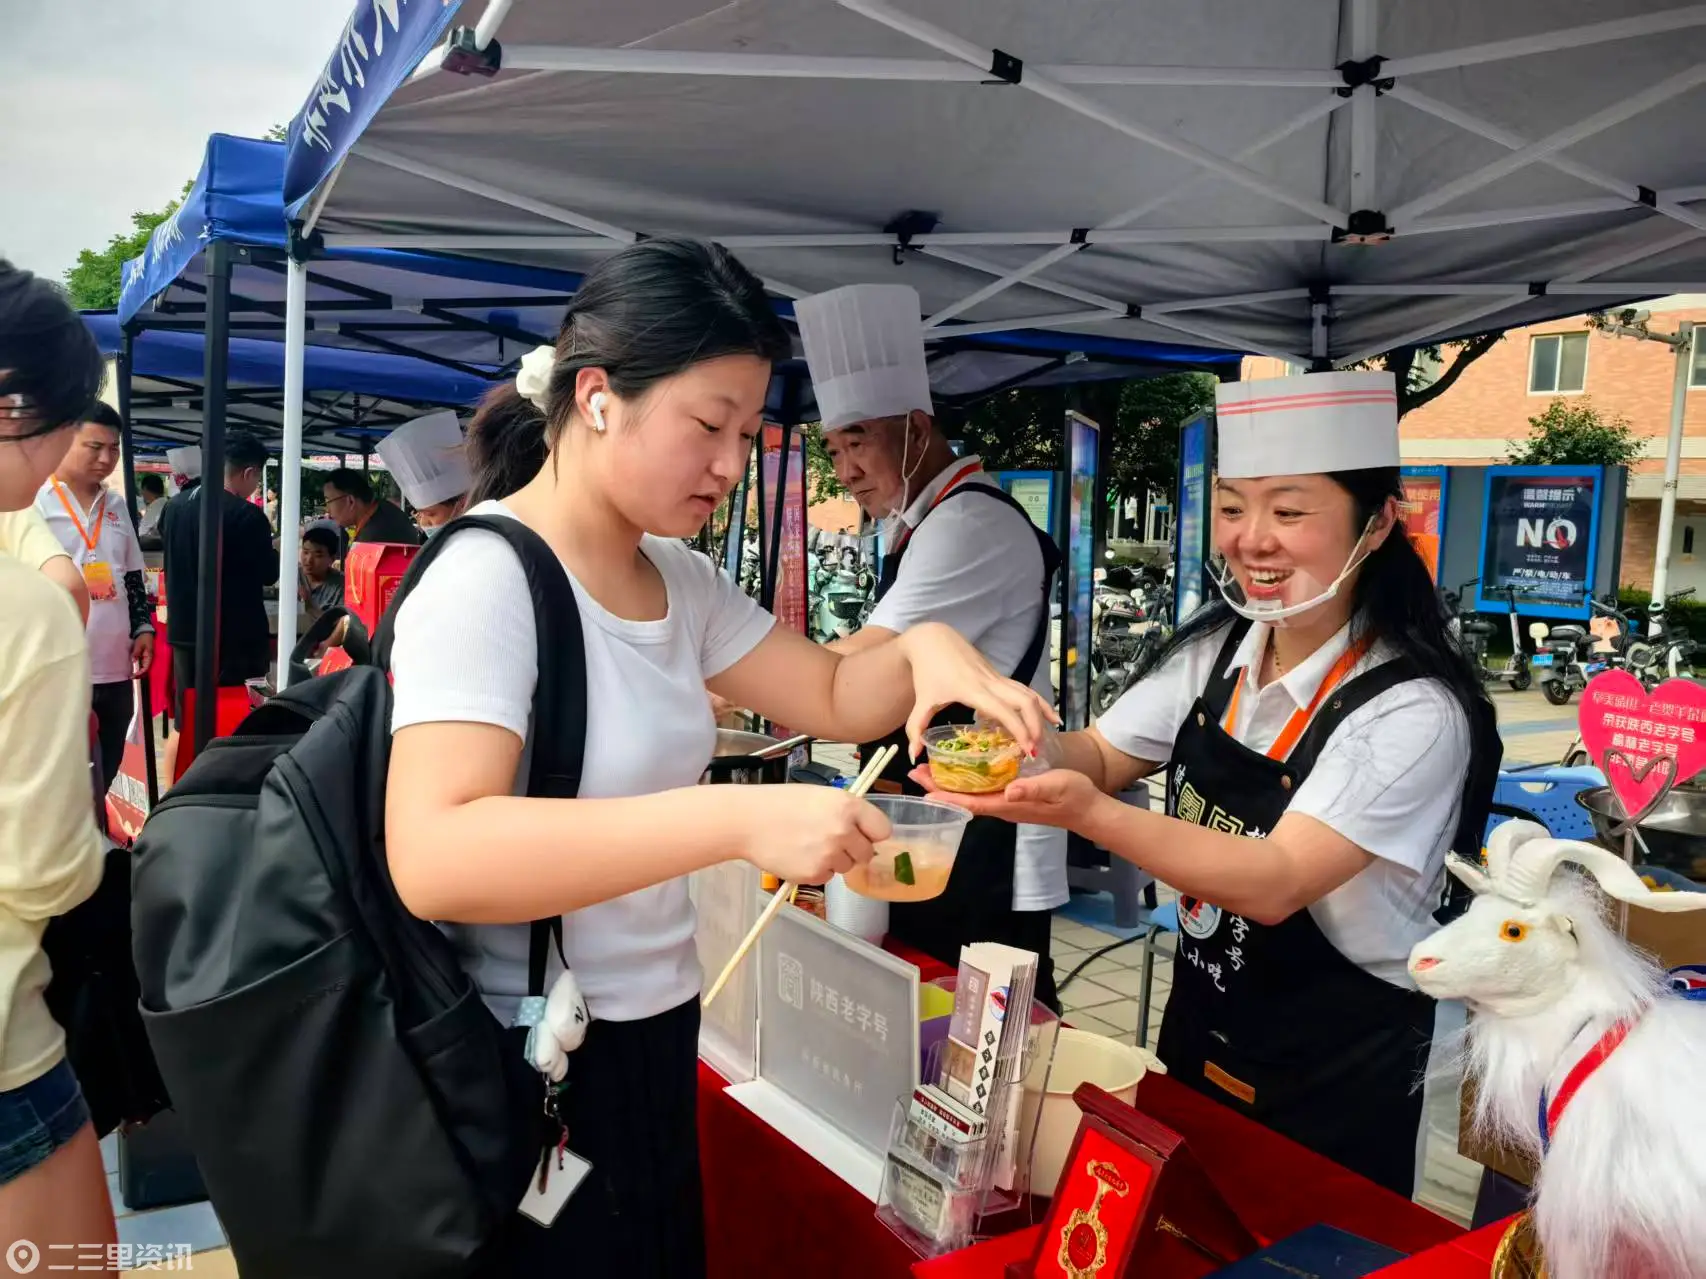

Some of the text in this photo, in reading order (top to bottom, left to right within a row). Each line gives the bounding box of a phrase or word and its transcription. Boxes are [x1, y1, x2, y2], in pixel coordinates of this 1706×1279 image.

[1523, 488, 1575, 501] 温馨提示
[1516, 518, 1577, 550] NO
[810, 977, 888, 1041] 陕西老字号
